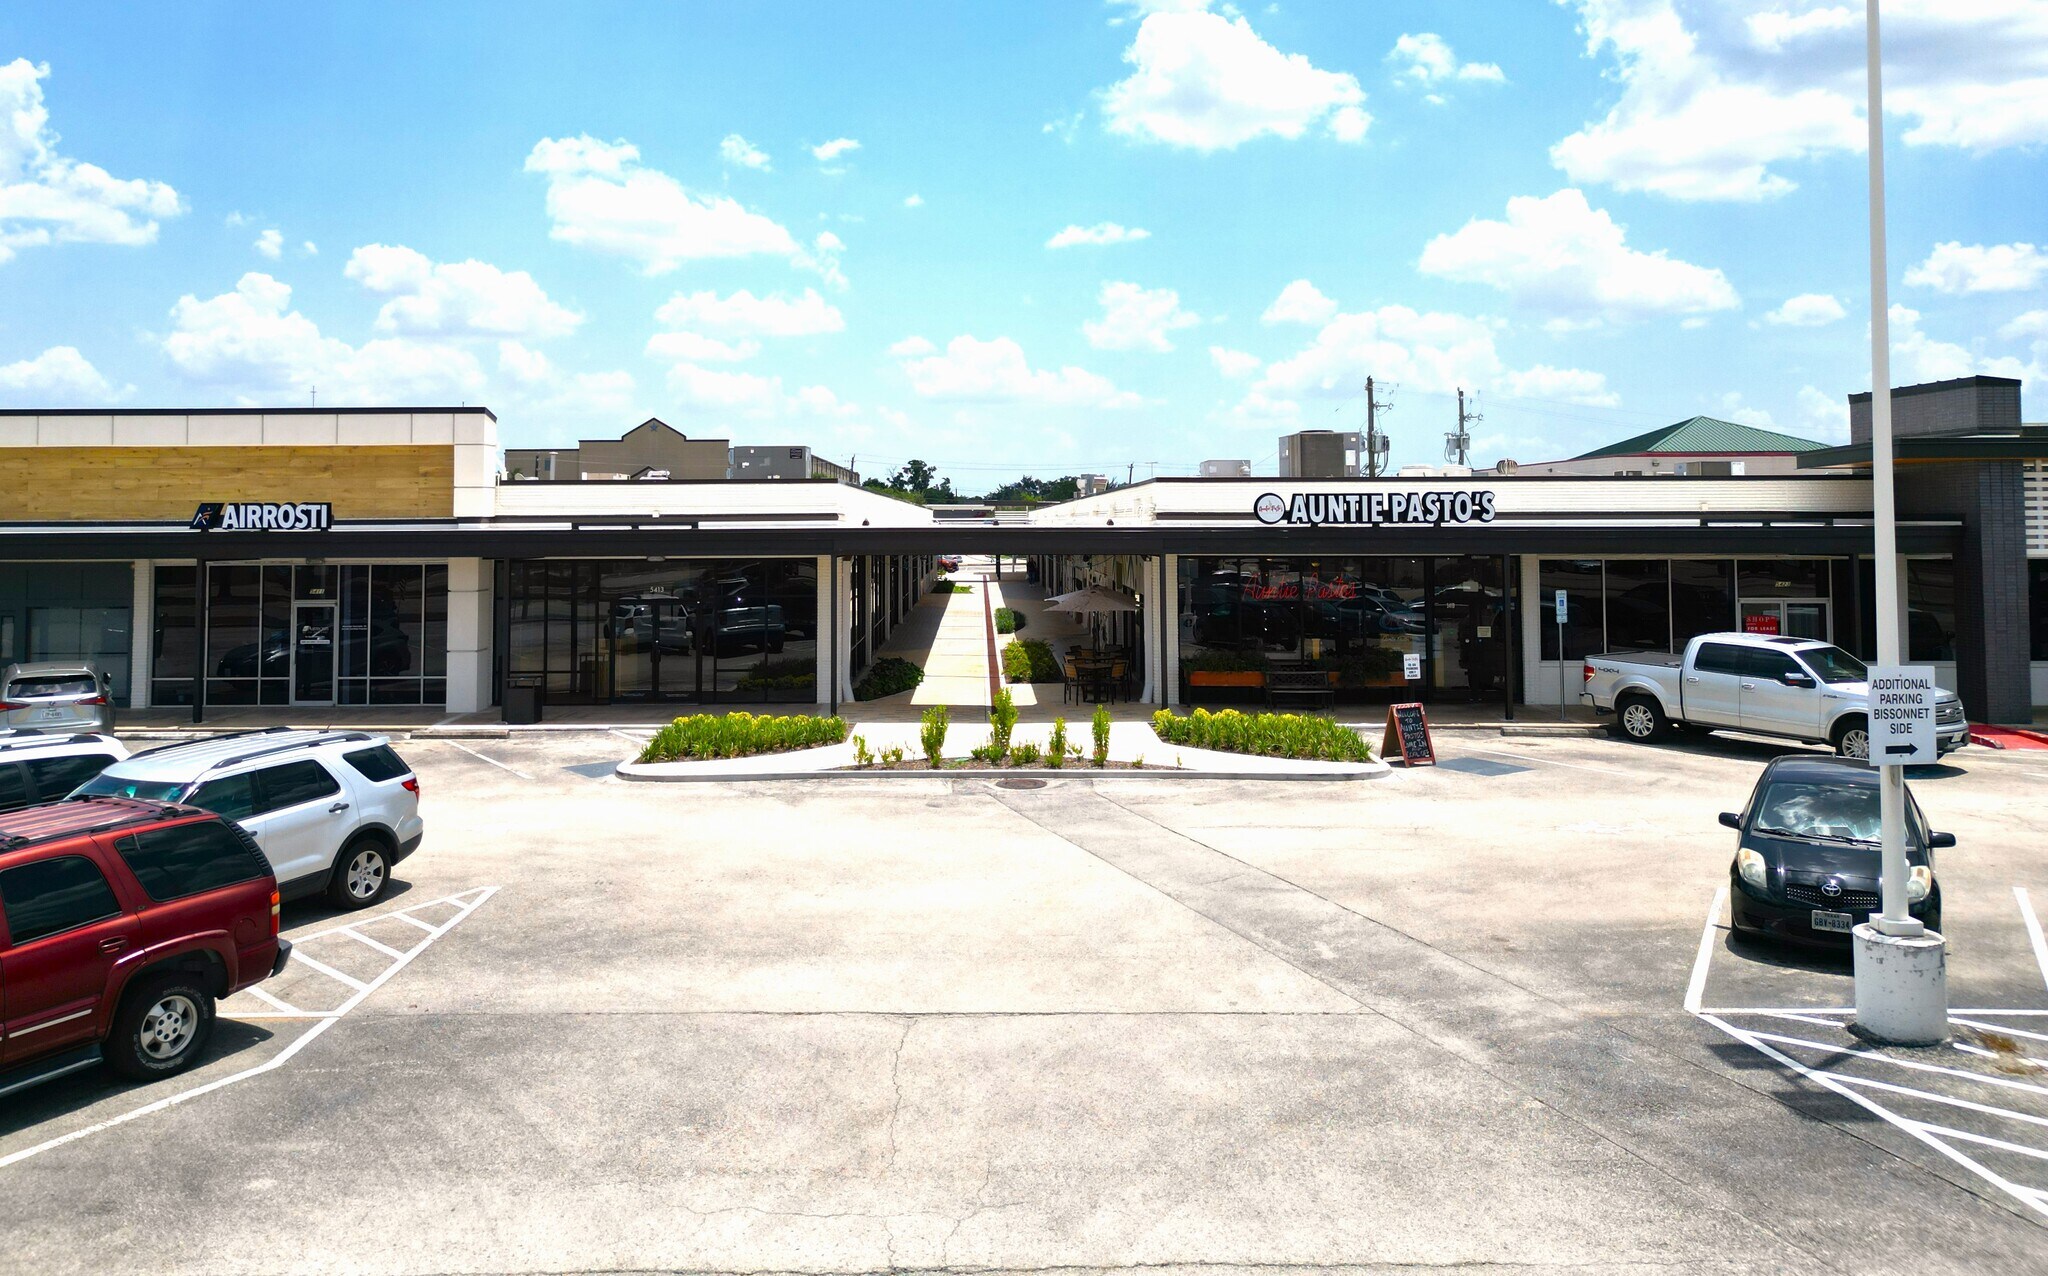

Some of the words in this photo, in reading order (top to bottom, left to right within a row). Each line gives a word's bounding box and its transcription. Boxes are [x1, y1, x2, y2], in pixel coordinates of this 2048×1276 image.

[1291, 494, 1383, 523] AUNTIE
[1392, 492, 1495, 523] PASTO'S
[222, 504, 328, 528] AIRROSTI
[1242, 573, 1299, 600] Auntie
[1872, 679, 1931, 690] ADDITIONAL
[1880, 693, 1923, 705] PARKING
[1873, 708, 1930, 719] BISSONNET
[1400, 722, 1424, 732] AUNTIE
[1890, 723, 1913, 734] SIDE
